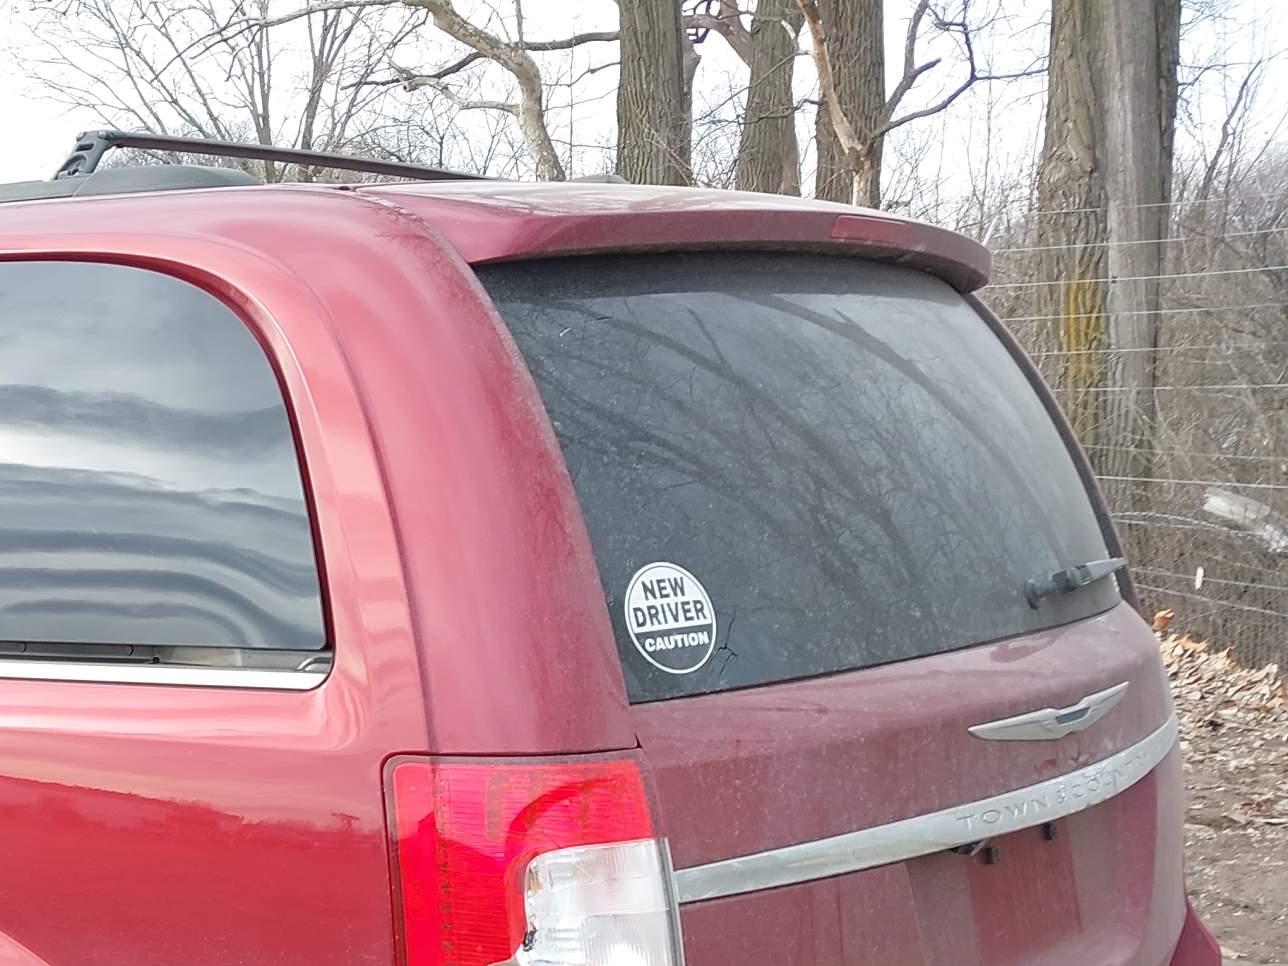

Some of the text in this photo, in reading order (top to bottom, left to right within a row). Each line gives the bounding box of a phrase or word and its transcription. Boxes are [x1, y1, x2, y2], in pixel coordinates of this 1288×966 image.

[641, 577, 686, 601] NEW
[633, 600, 707, 628] DRIVER
[644, 631, 710, 652] CAUTION
[957, 794, 1051, 831] TOWN
